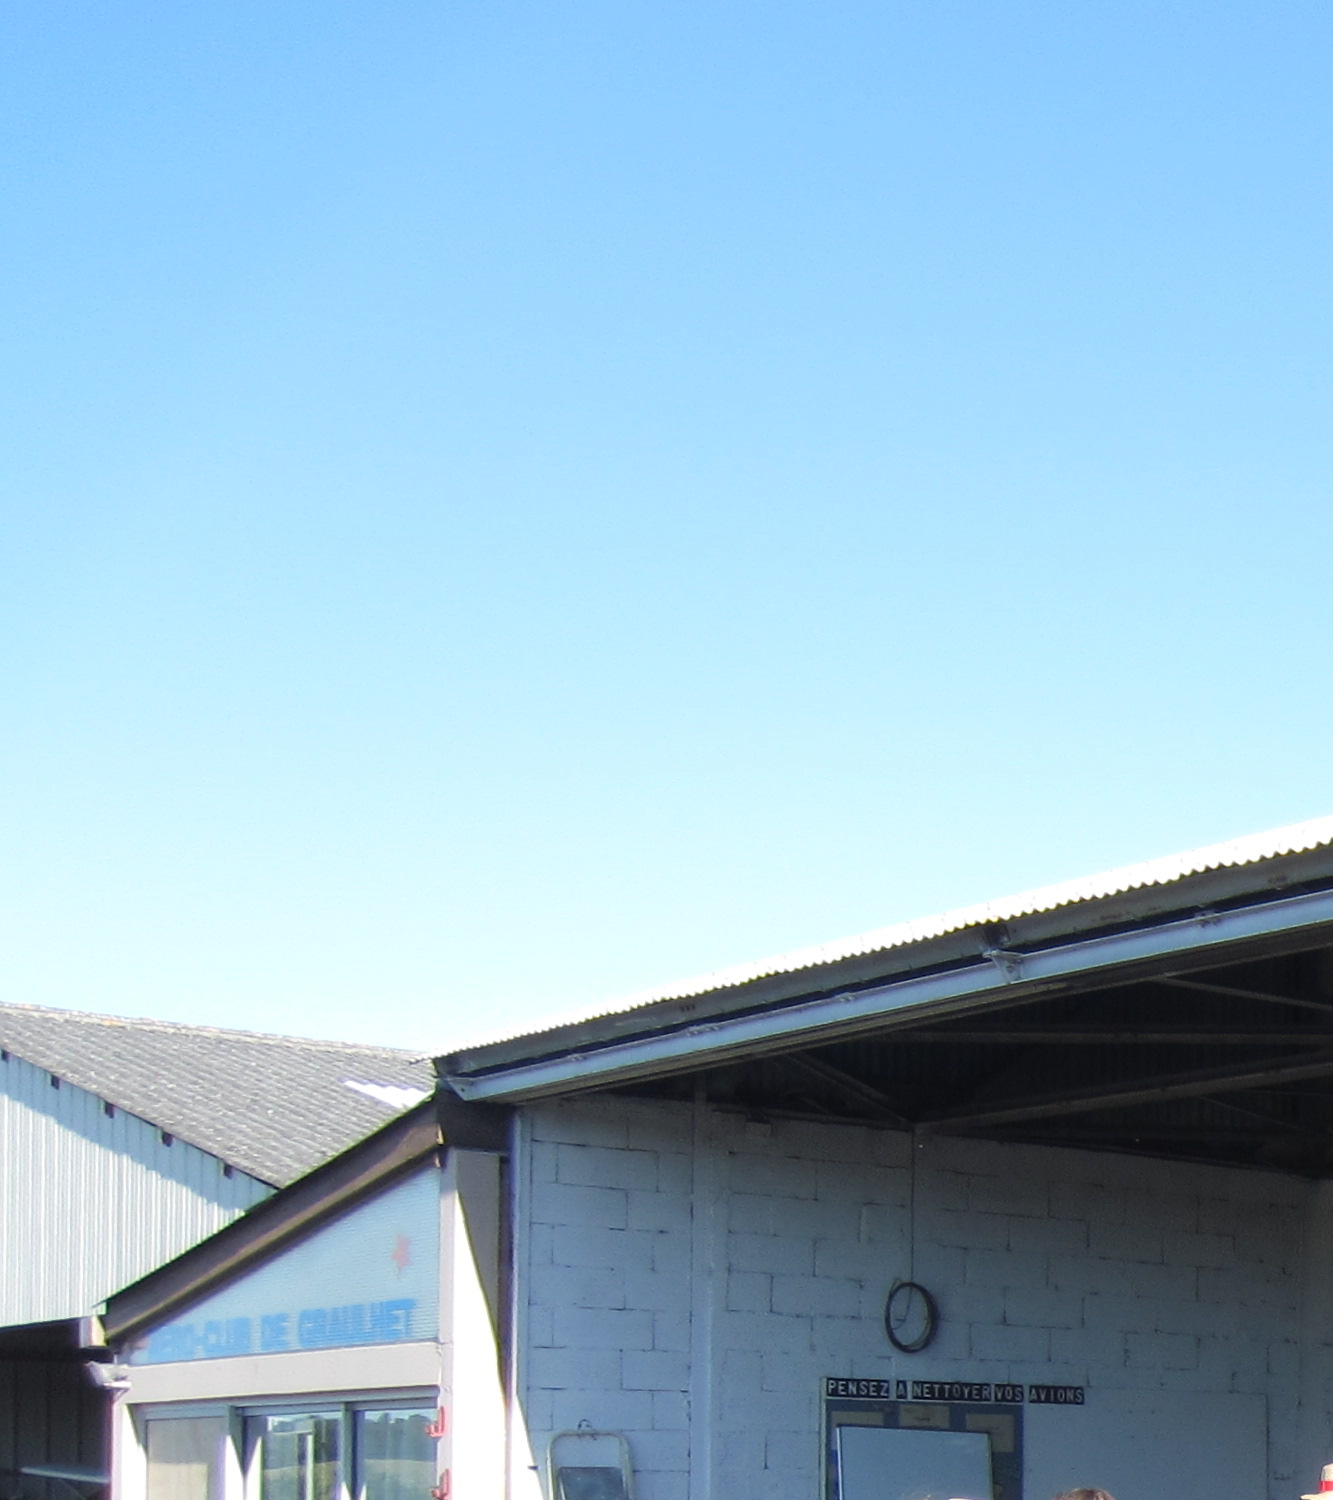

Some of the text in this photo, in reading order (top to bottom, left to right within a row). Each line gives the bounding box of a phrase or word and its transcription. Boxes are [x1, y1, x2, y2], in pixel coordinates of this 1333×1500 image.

[260, 1312, 289, 1351] DE
[827, 1379, 1085, 1404] PENSEZ A NETTOYER VOS AVIONS
